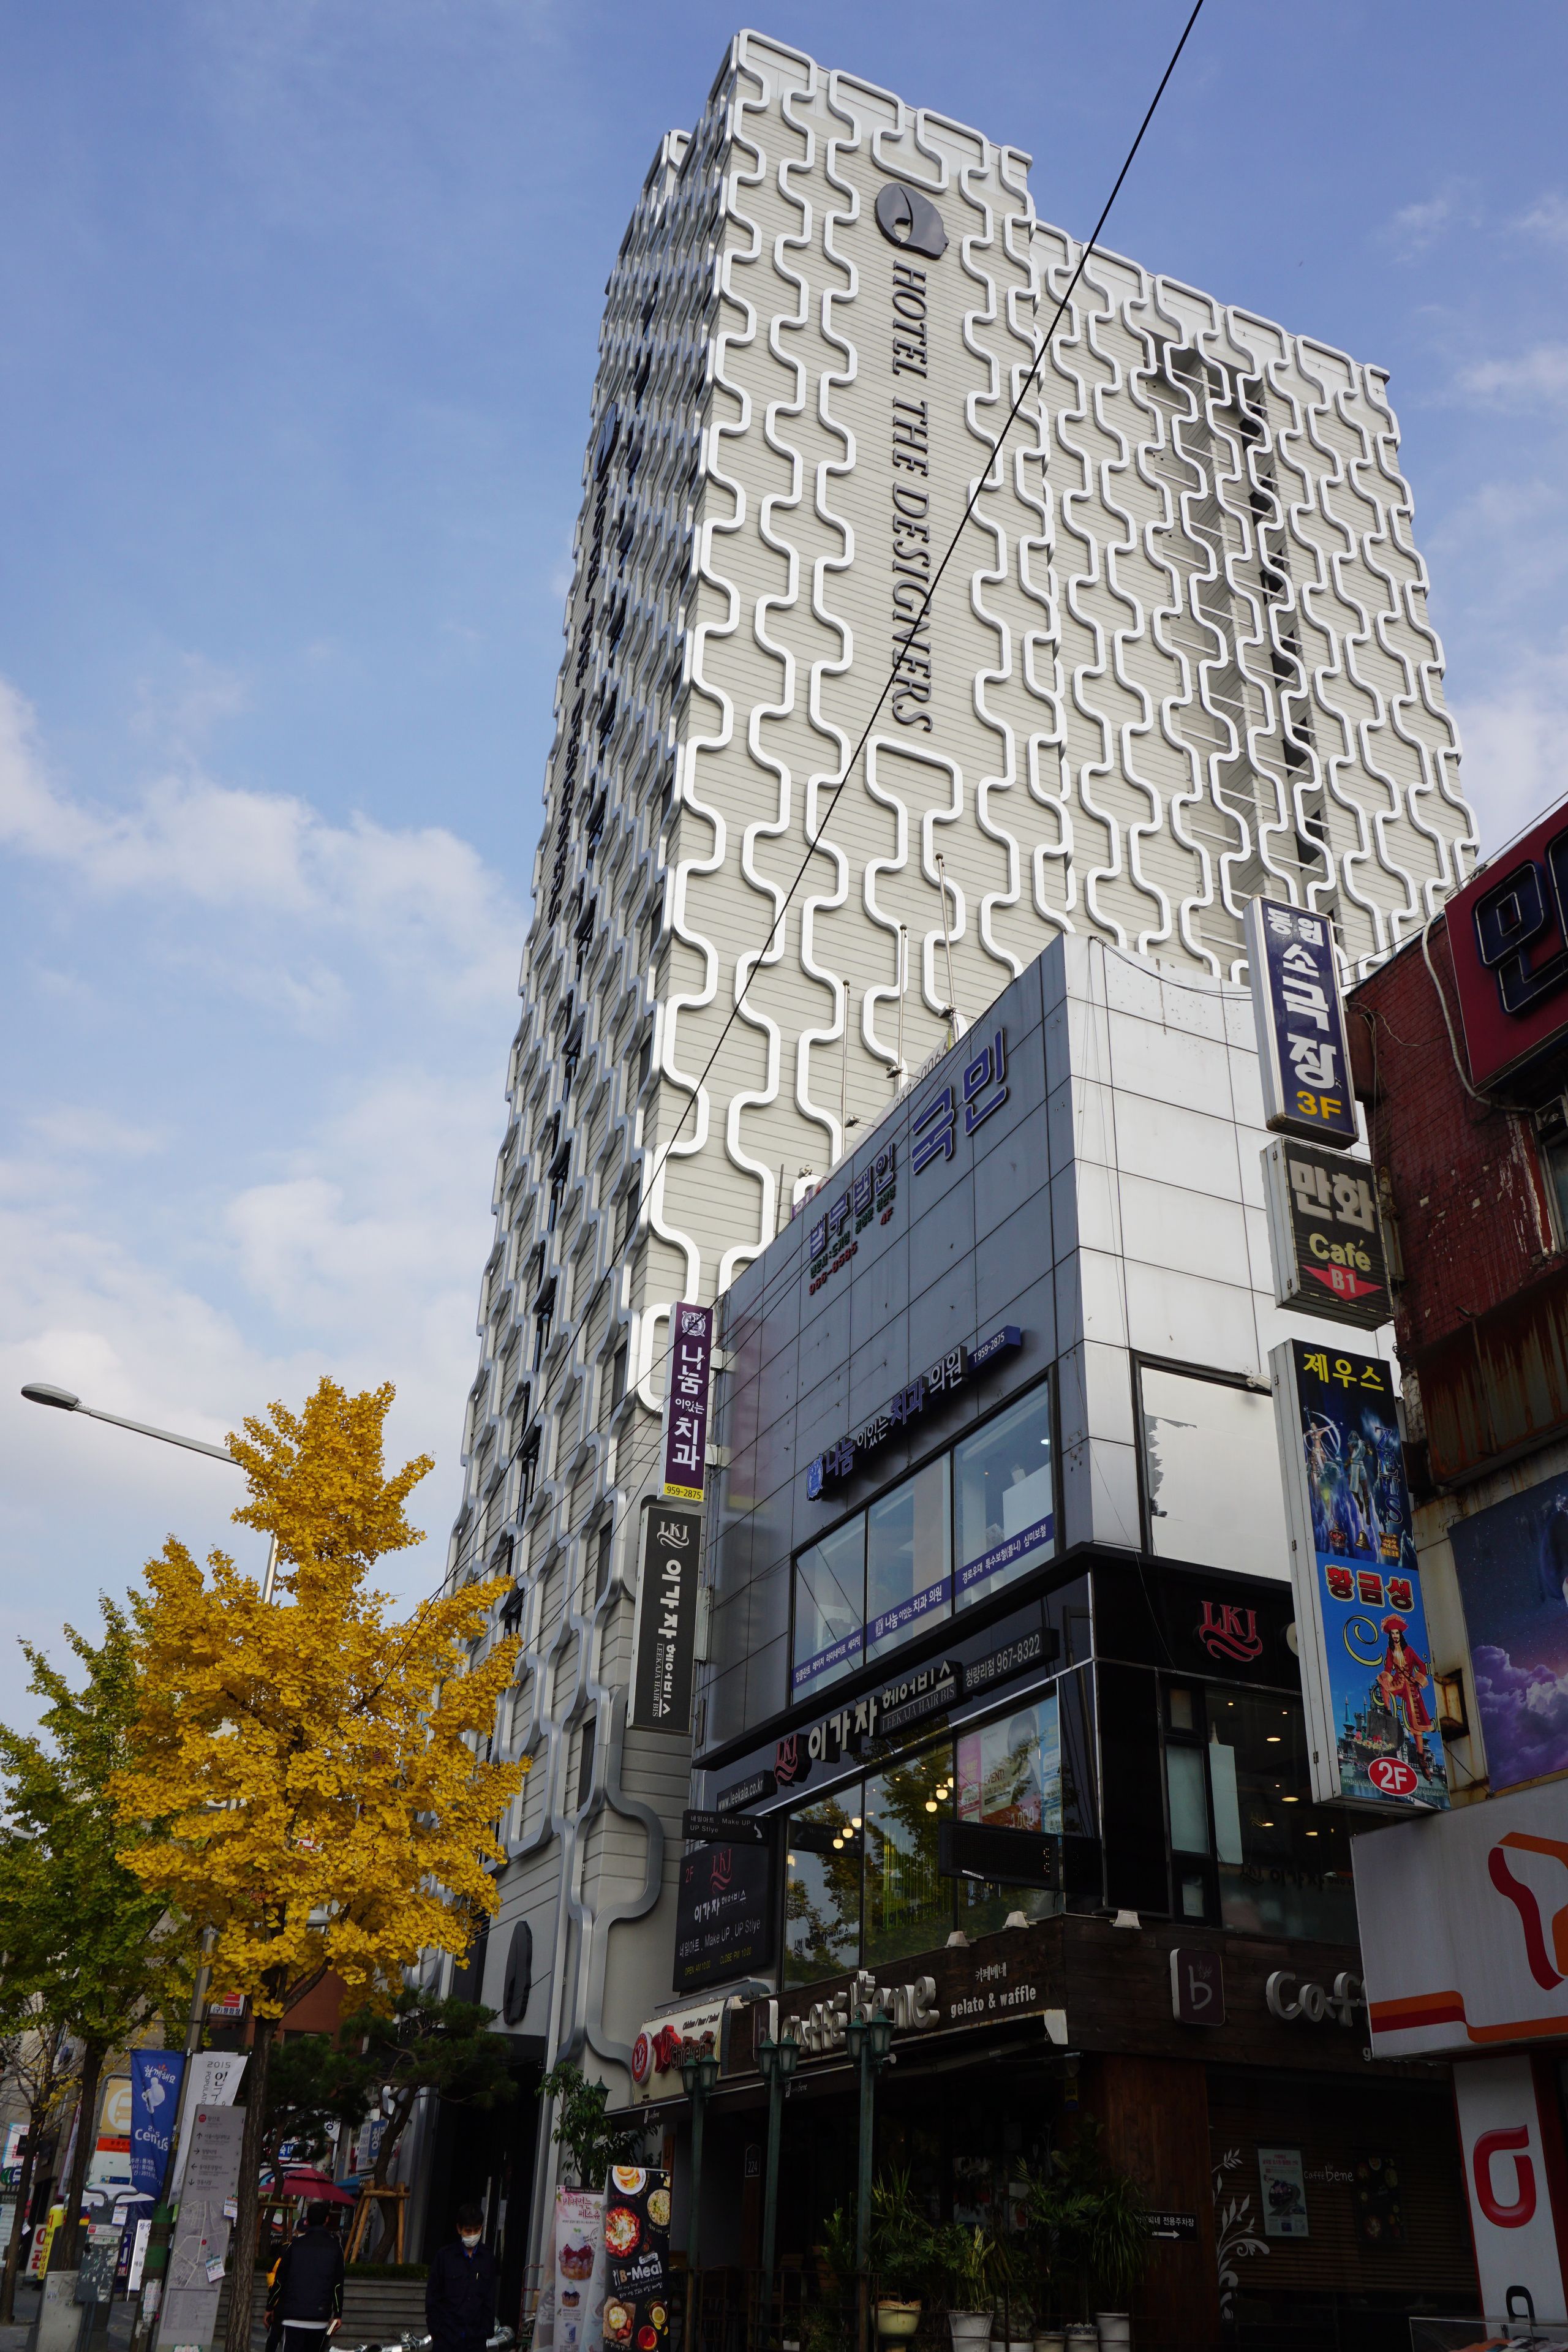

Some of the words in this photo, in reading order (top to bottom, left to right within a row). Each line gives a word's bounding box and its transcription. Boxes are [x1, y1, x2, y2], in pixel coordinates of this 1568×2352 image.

[892, 259, 928, 379] HOTEL
[892, 396, 929, 477] THE
[892, 481, 933, 733] DESIGNERS
[911, 1027, 1011, 1176] 국민
[1296, 1090, 1342, 1120] 3F
[810, 1143, 895, 1261] 법무법인
[1289, 1159, 1376, 1234] 만화
[1309, 1233, 1371, 1272] Café
[1331, 1268, 1356, 1294] B1
[677, 1344, 706, 1395] 나눔
[890, 1376, 926, 1425] 치과
[928, 1345, 963, 1395] 의원
[1303, 1352, 1384, 1392] 제우스
[675, 1398, 705, 1414] 이있는
[672, 1416, 701, 1471] 치과
[666, 1485, 701, 1499] 959-2875
[1374, 1426, 1403, 1525] ZEUS
[658, 1521, 689, 1544] LKJ
[962, 1561, 984, 1585] 경로우대
[985, 1539, 1022, 1569] 특수보철(틀니)
[1023, 1523, 1047, 1547] 심미보철
[658, 1559, 682, 1639] 이가자
[1325, 1564, 1415, 1613] 황금성
[884, 1611, 899, 1630] 나눔
[913, 1593, 927, 1613] 치과
[929, 1585, 943, 1604] 의원
[1200, 1600, 1260, 1653] LKJ
[655, 1643, 663, 1679] LEEKAJA
[795, 1668, 811, 1683] 임플란트
[813, 1657, 825, 1672] 레이저
[826, 1645, 846, 1664] 라미네이트
[965, 1659, 995, 1688] 청량리점
[997, 1634, 1041, 1675] 967-8322
[658, 1644, 676, 1717] 헤어비스
[808, 1695, 878, 1762] 이가자
[882, 1659, 956, 1709] 헤어비스
[919, 1694, 939, 1716] HAIR
[941, 1684, 956, 1704] BIS
[1378, 1760, 1408, 1791] 2F
[718, 1778, 764, 1812] www.leekaja.co.kr
[690, 1815, 715, 1823] 네일아트
[685, 1865, 695, 1883] 2F
[694, 1896, 720, 1923] 이가자
[679, 1938, 700, 1958] 네일아트
[704, 1932, 720, 1948] Make
[722, 1927, 730, 1942] UP
[735, 1922, 744, 1937] UP
[720, 1952, 733, 1965] CLOSE
[976, 1962, 1008, 1982] 카페베네
[951, 1991, 984, 2019] gelato
[988, 1995, 997, 2010] &
[1000, 1984, 1037, 2007] waffle
[1265, 1970, 1368, 2027] Caf
[143, 2065, 176, 2084] 함께해요
[747, 2160, 758, 2174] 224
[1325, 2165, 1354, 2182] bene
[562, 2196, 592, 2209] 비벼먹는
[1163, 2216, 1194, 2228] 전용주차장
[619, 2260, 663, 2284] B-Meal
